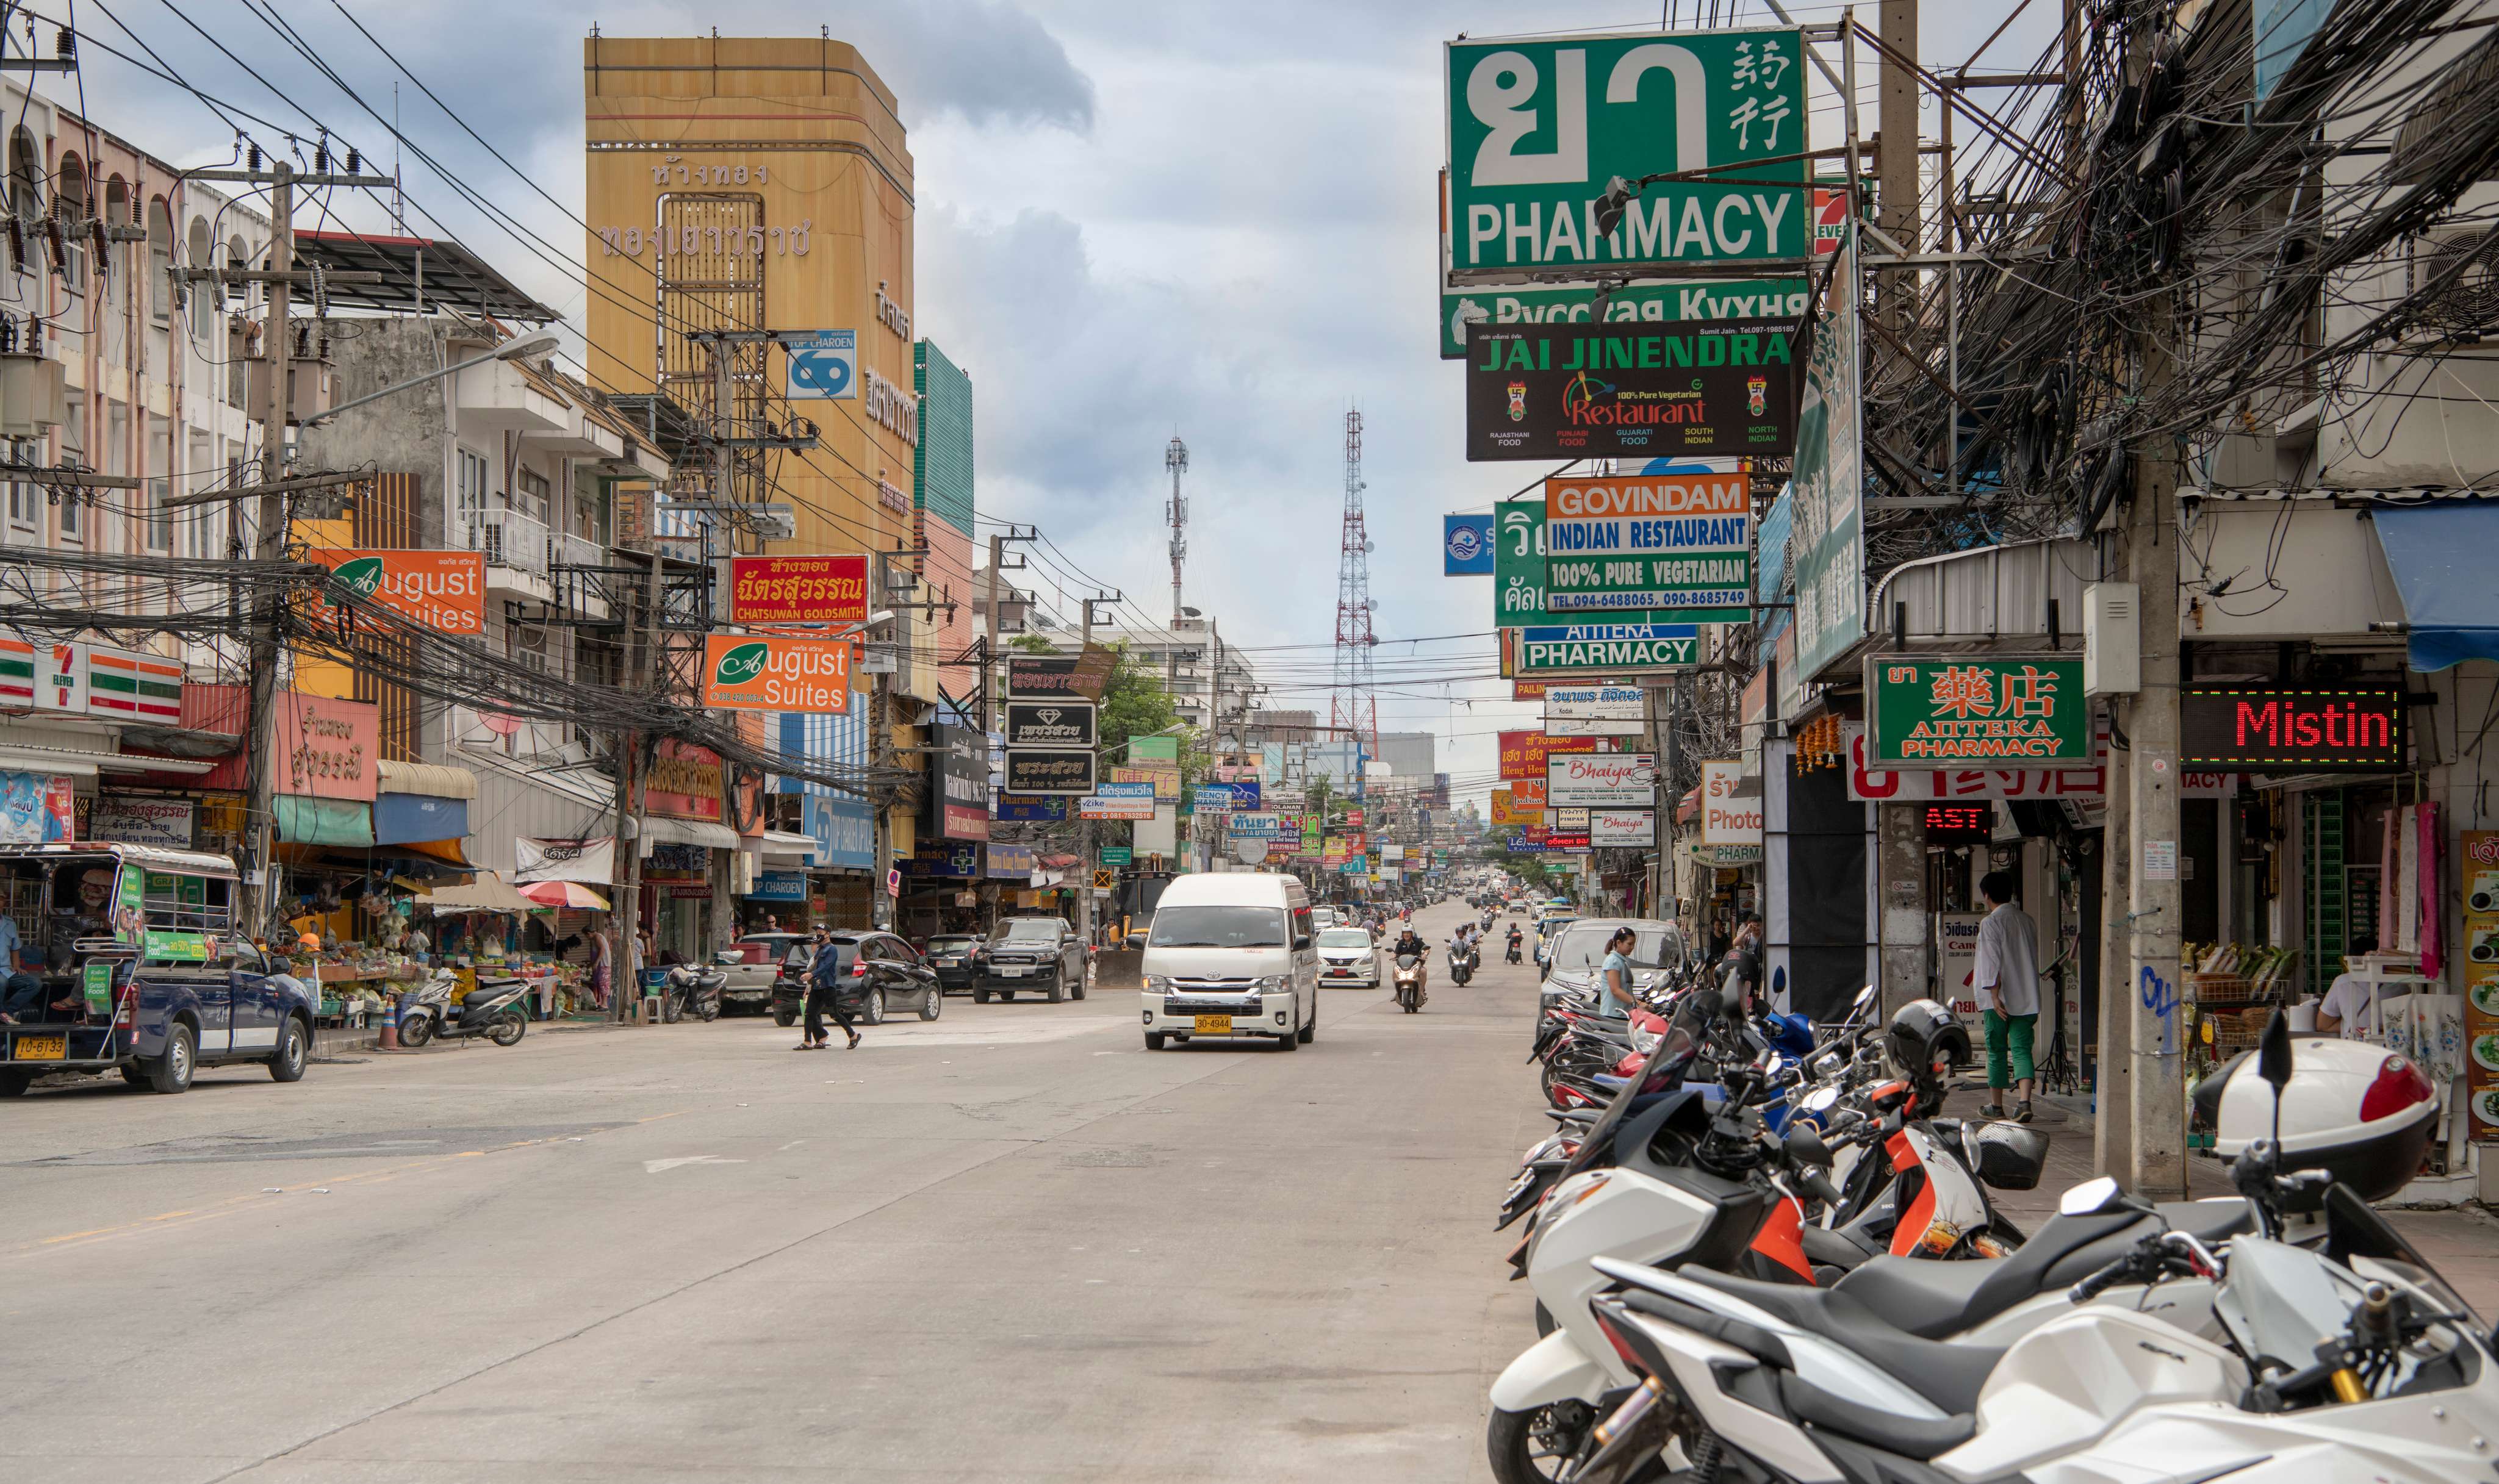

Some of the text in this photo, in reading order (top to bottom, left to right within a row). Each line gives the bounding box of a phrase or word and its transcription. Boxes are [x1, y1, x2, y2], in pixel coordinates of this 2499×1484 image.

[1466, 43, 1708, 187] ยา
[652, 156, 769, 184] ห้างทอง
[599, 219, 812, 256] ทองเยาวราช
[1469, 193, 1792, 264] PHARMACY
[1814, 225, 1849, 238] EVE
[1740, 325, 1794, 334] Tel.097-1985185
[810, 338, 853, 348] CHAROEN
[1480, 332, 1791, 371] JAI JINENDRA
[1658, 390, 1701, 400] Vegetarian
[1572, 399, 1706, 426] Restaurant
[1559, 438, 1586, 446] FOOD
[1557, 482, 1741, 514] GOVINDAM
[1553, 518, 1745, 550] INDIAN RESTAURANT
[771, 558, 829, 573] ห้างทอง
[1552, 559, 1745, 587] 100% PURE VEGETARIAN
[737, 571, 862, 608] ฉัตรสุวรรณ
[1553, 590, 1745, 608] TEL.094-6488065, 090-8685749
[738, 606, 863, 619] CHATSUWAN GOLDSMITH
[1530, 642, 1692, 667] PHARMACY
[720, 648, 844, 681] August
[53, 674, 73, 687] ELEVEN
[54, 644, 73, 706] 7
[1888, 667, 1916, 683] ยา
[718, 692, 731, 701] 038
[733, 693, 744, 701] 420
[764, 679, 842, 708] Suites
[1518, 685, 1545, 694] PAILIN
[1552, 690, 1597, 703] วนาพร
[1929, 665, 2060, 719] 藥店
[1908, 720, 2055, 739] АПТЕКА
[2236, 700, 2388, 748] Mistin
[1503, 750, 1520, 762] เฮง
[1525, 748, 1543, 762] เฮง
[1902, 738, 2063, 757] PHARMACY
[1503, 765, 1524, 776] Heng
[1569, 760, 1633, 787] Bhaiya
[1000, 794, 1045, 806] Pharmacy
[1514, 795, 1544, 809] Indian
[1234, 814, 1278, 829] ทันยา
[1602, 816, 1644, 833] Bhaiya
[1709, 809, 1763, 830] Photo
[766, 882, 800, 893] CHAROEN
[20, 1042, 63, 1053] 10-6133
